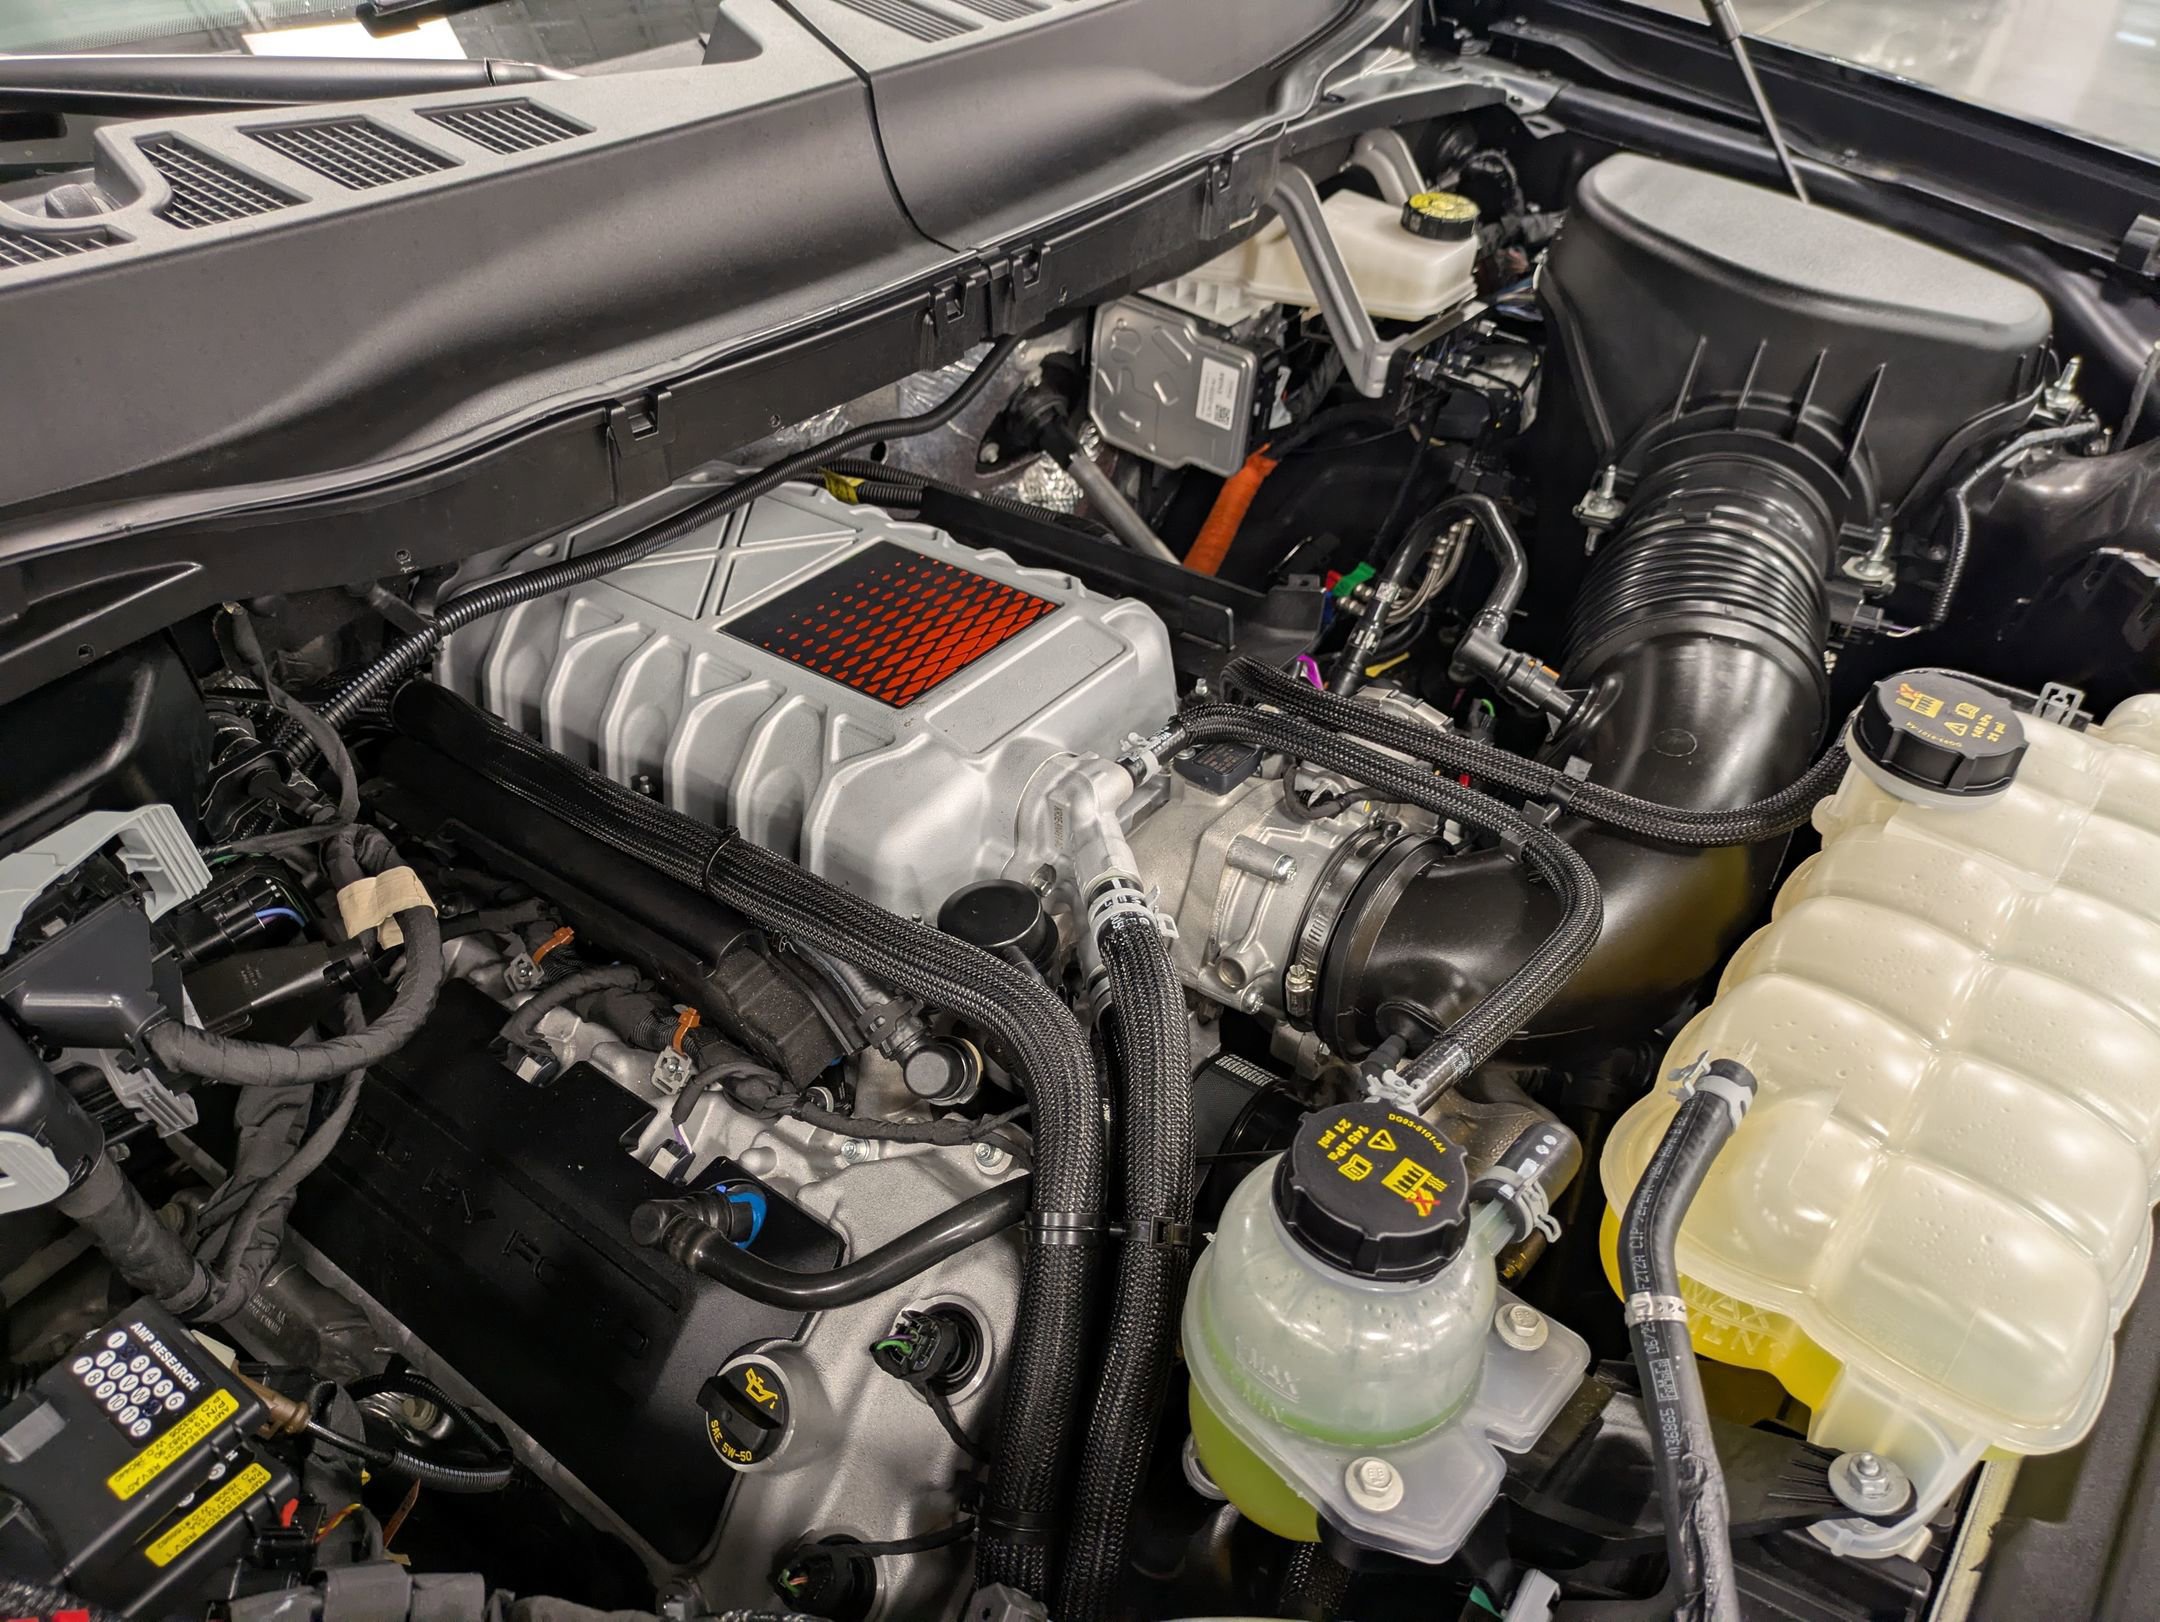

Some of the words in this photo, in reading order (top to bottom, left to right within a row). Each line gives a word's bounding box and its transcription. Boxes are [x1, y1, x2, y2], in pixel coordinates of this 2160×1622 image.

[1334, 1118, 1352, 1134] 21
[1347, 1125, 1370, 1145] 145
[1317, 1129, 1337, 1149] psi
[1326, 1141, 1353, 1161] kPa
[130, 1321, 155, 1344] AMP
[150, 1340, 200, 1391] RESEARCH
[206, 1400, 225, 1418] P/N
[212, 1406, 230, 1422] AMP
[164, 1421, 212, 1461] RESEARCH
[711, 1420, 723, 1443] SAE
[721, 1442, 752, 1461] 5W-50
[175, 1532, 197, 1552] REV
